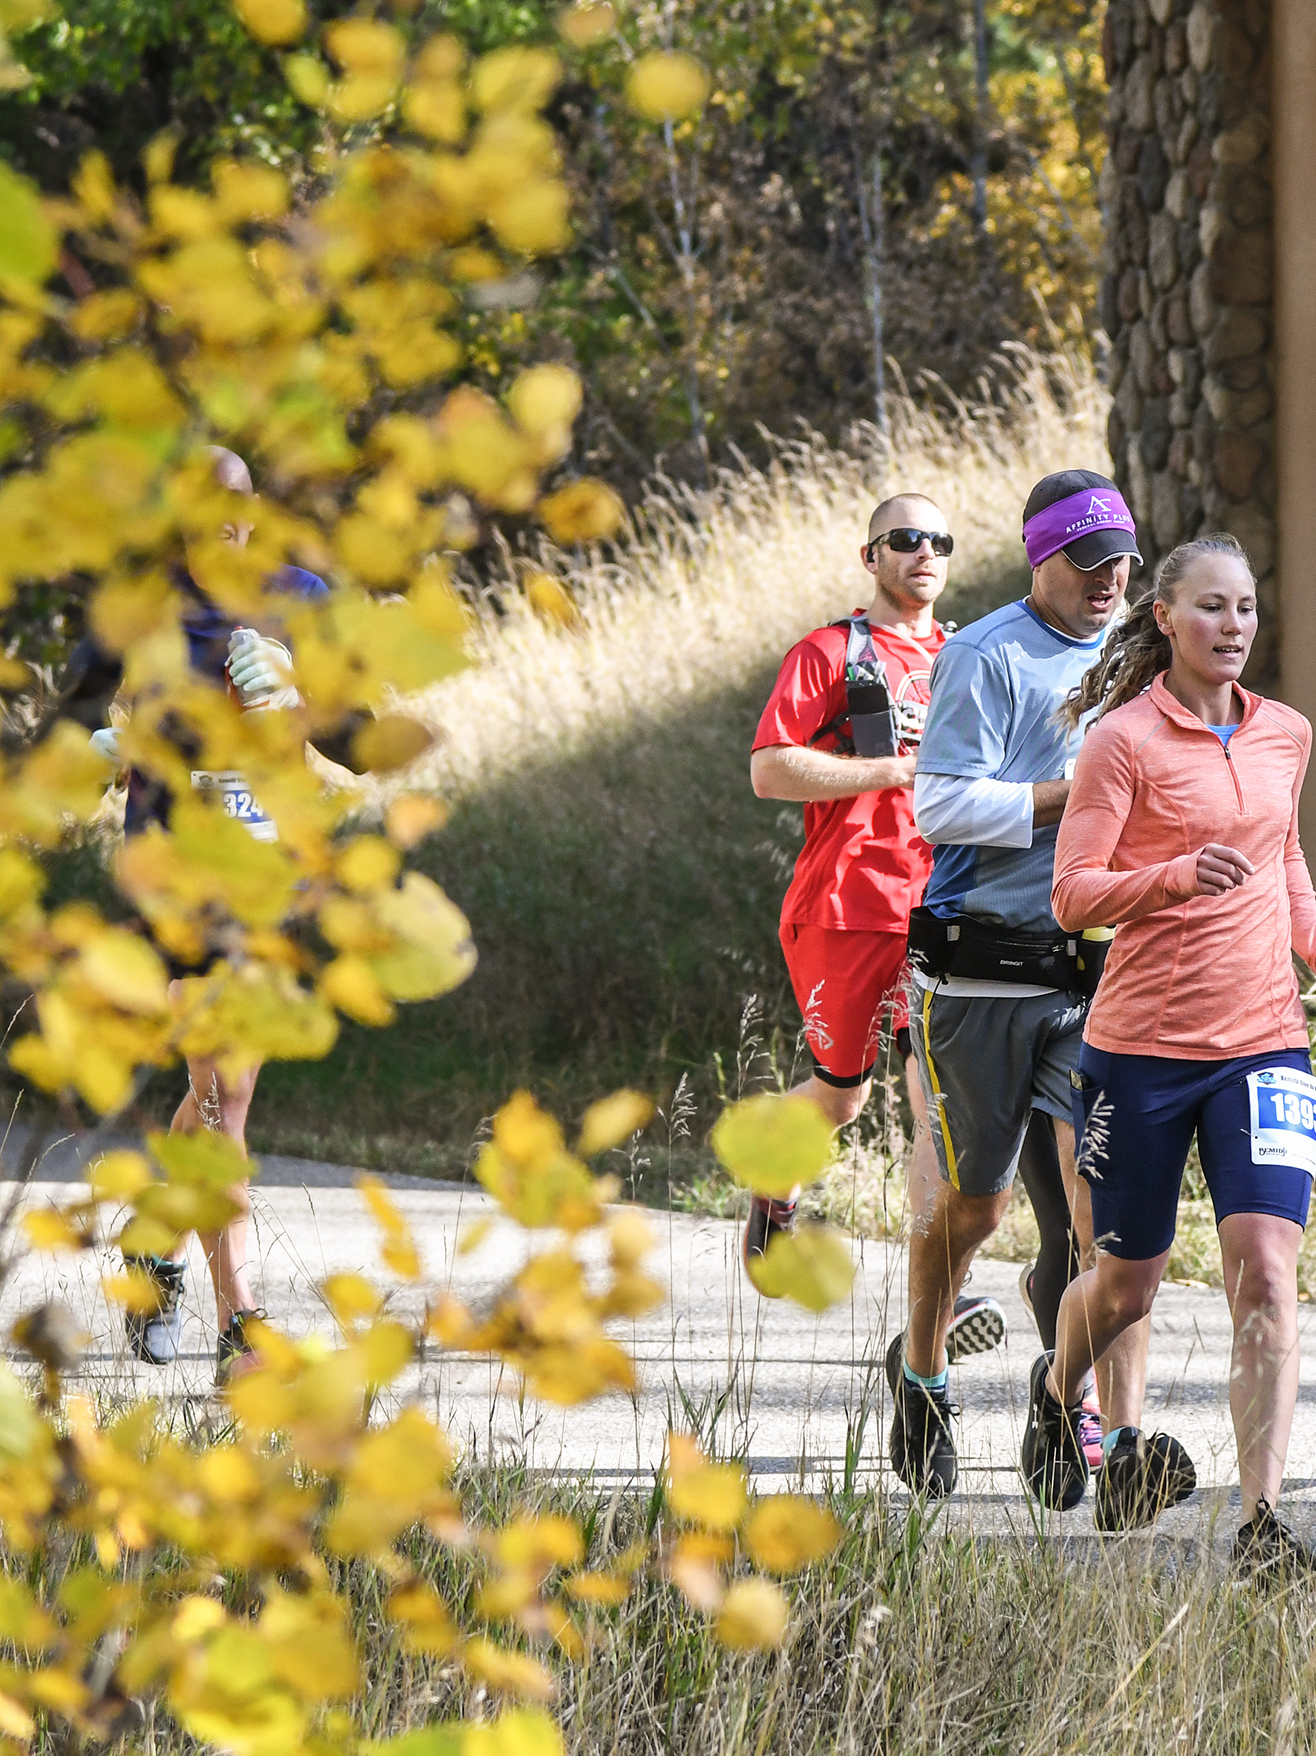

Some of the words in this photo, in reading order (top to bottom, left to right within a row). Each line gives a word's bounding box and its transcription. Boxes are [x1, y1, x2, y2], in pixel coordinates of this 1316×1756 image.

[1066, 514, 1109, 533] AFFINITY
[1113, 514, 1130, 522] PLUS
[222, 792, 264, 818] 324
